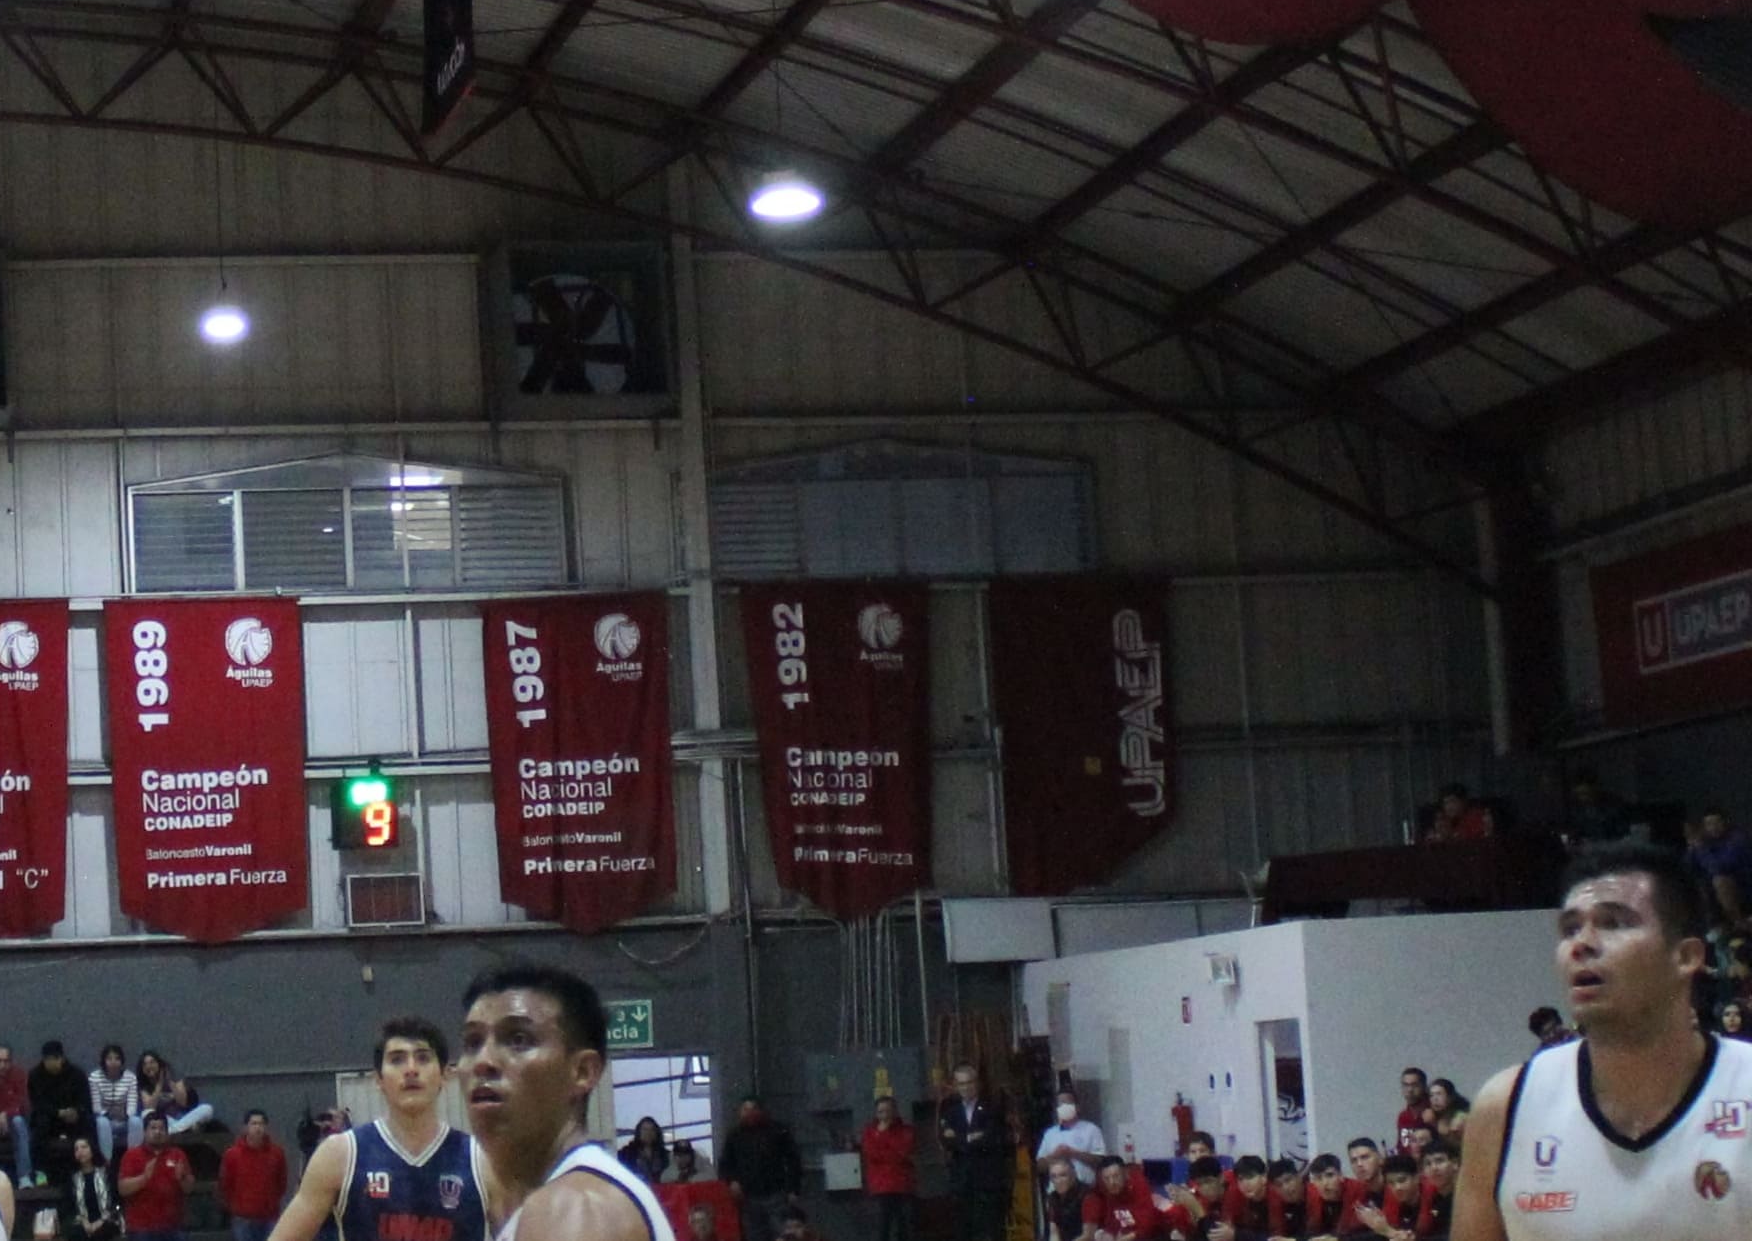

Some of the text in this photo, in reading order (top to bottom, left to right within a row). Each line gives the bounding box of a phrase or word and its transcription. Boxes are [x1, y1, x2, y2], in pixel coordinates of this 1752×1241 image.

[773, 602, 809, 710] 1982
[133, 620, 169, 732] 1989
[506, 620, 547, 728] 1987
[1112, 609, 1165, 818] UPAEP
[141, 764, 268, 791] Campeón
[519, 752, 640, 780] Campeón
[142, 789, 240, 813] Nacional
[520, 777, 612, 800] Nacional
[143, 812, 234, 832] CONADEIP
[366, 801, 391, 845] 9
[147, 868, 287, 889] Primera Fuerza
